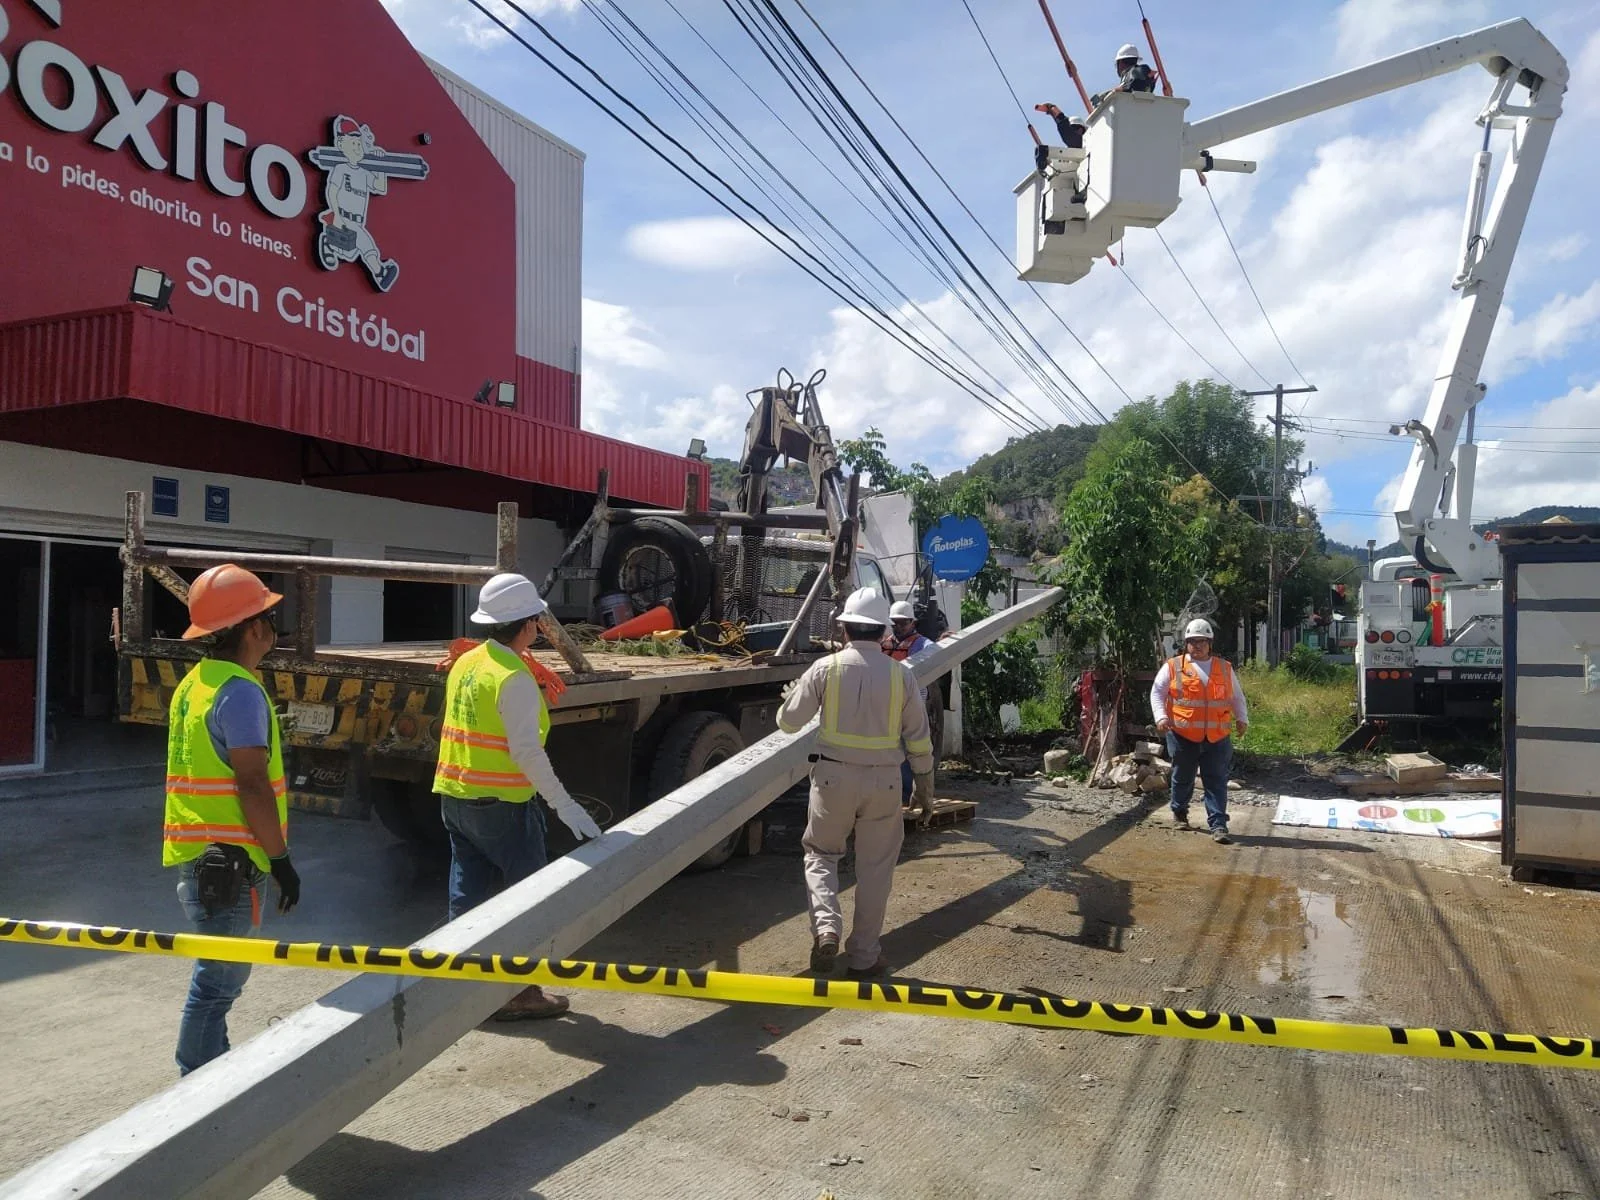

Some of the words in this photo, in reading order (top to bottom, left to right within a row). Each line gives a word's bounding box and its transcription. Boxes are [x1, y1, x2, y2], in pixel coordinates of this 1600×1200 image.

[0, 38, 308, 220] oxito
[26, 145, 50, 174] lo
[62, 164, 125, 202] pides,
[129, 187, 202, 228] ahorita
[212, 212, 232, 237] lo
[240, 223, 297, 260] tienes.
[186, 256, 259, 313] San
[276, 286, 425, 362] Cristóbal
[934, 537, 974, 553] Rotoplas
[1452, 647, 1486, 665] CFE
